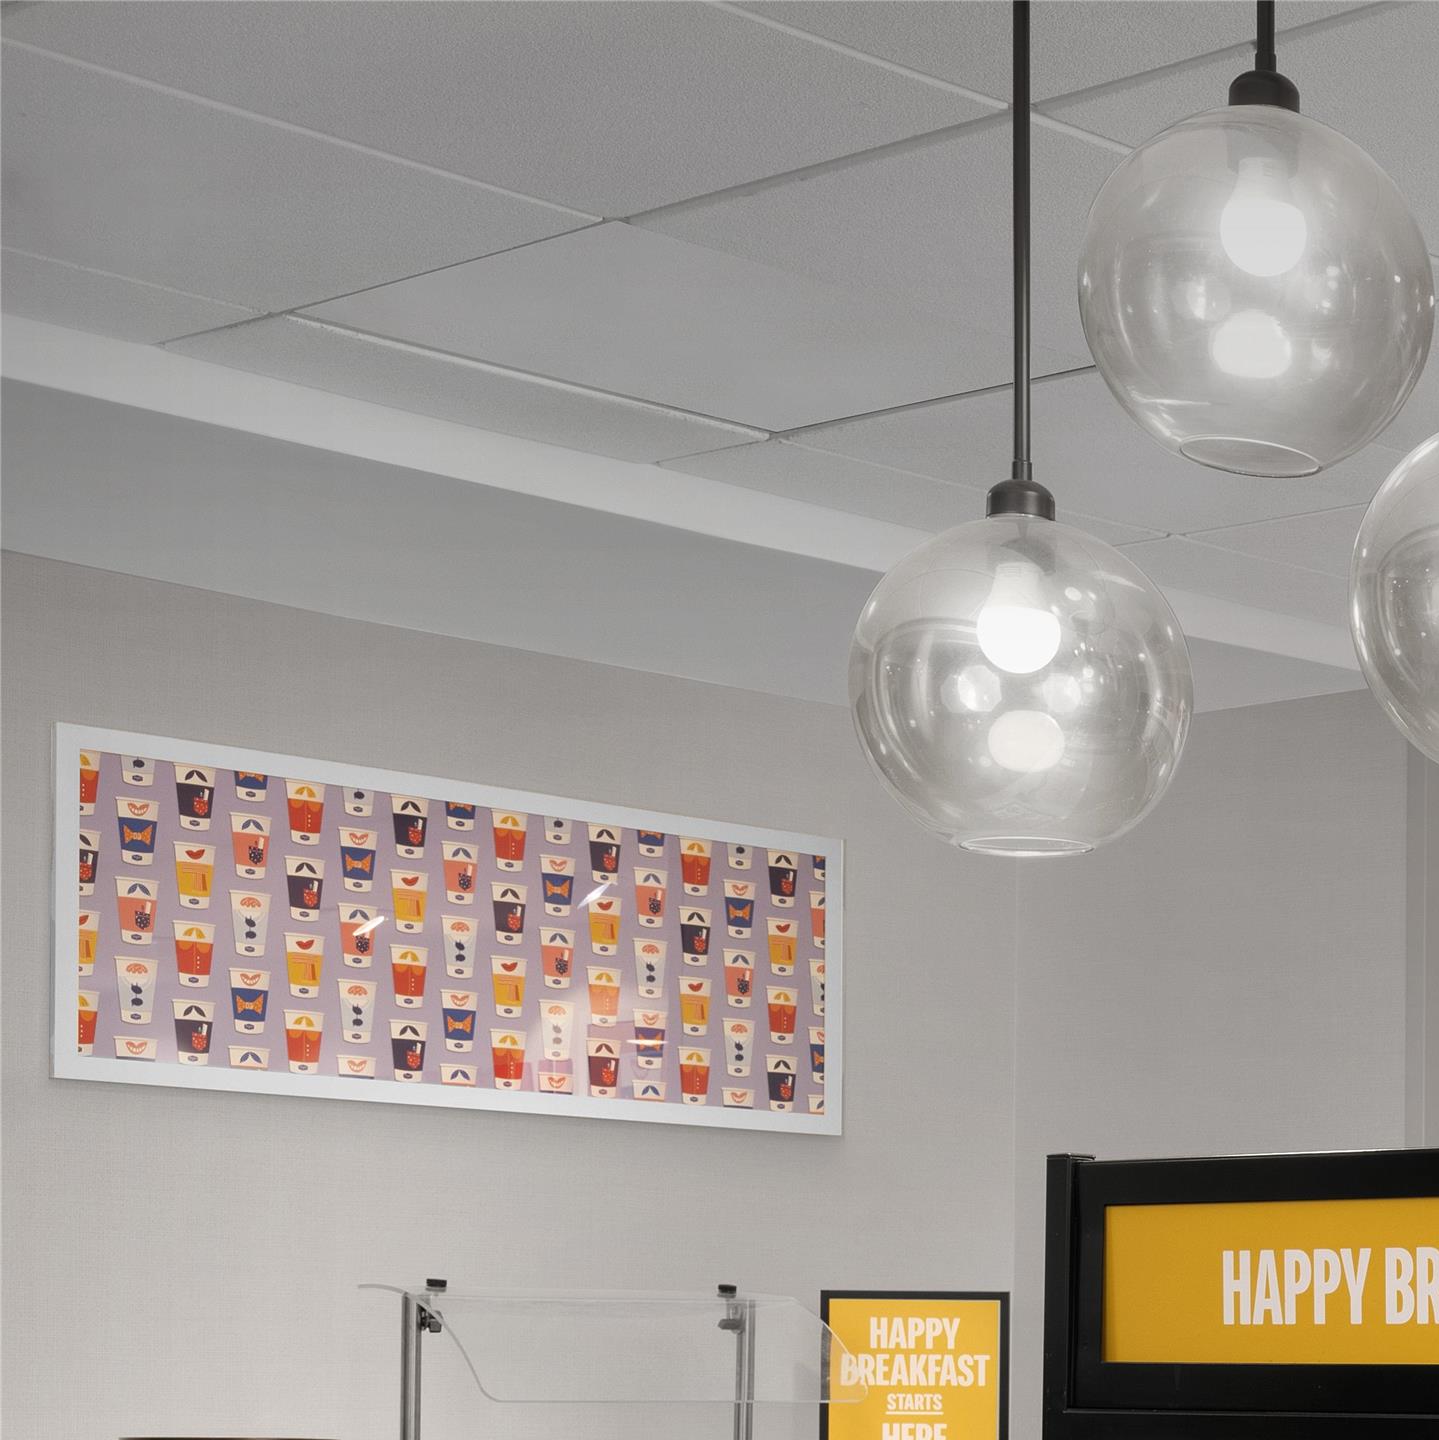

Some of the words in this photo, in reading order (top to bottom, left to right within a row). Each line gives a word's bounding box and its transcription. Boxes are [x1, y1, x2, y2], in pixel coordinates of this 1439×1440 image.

[1222, 1247, 1372, 1326] HAPPY
[869, 1316, 961, 1350] HAPPY
[840, 1353, 990, 1388] BREAKFAST
[887, 1392, 943, 1411] STARTS
